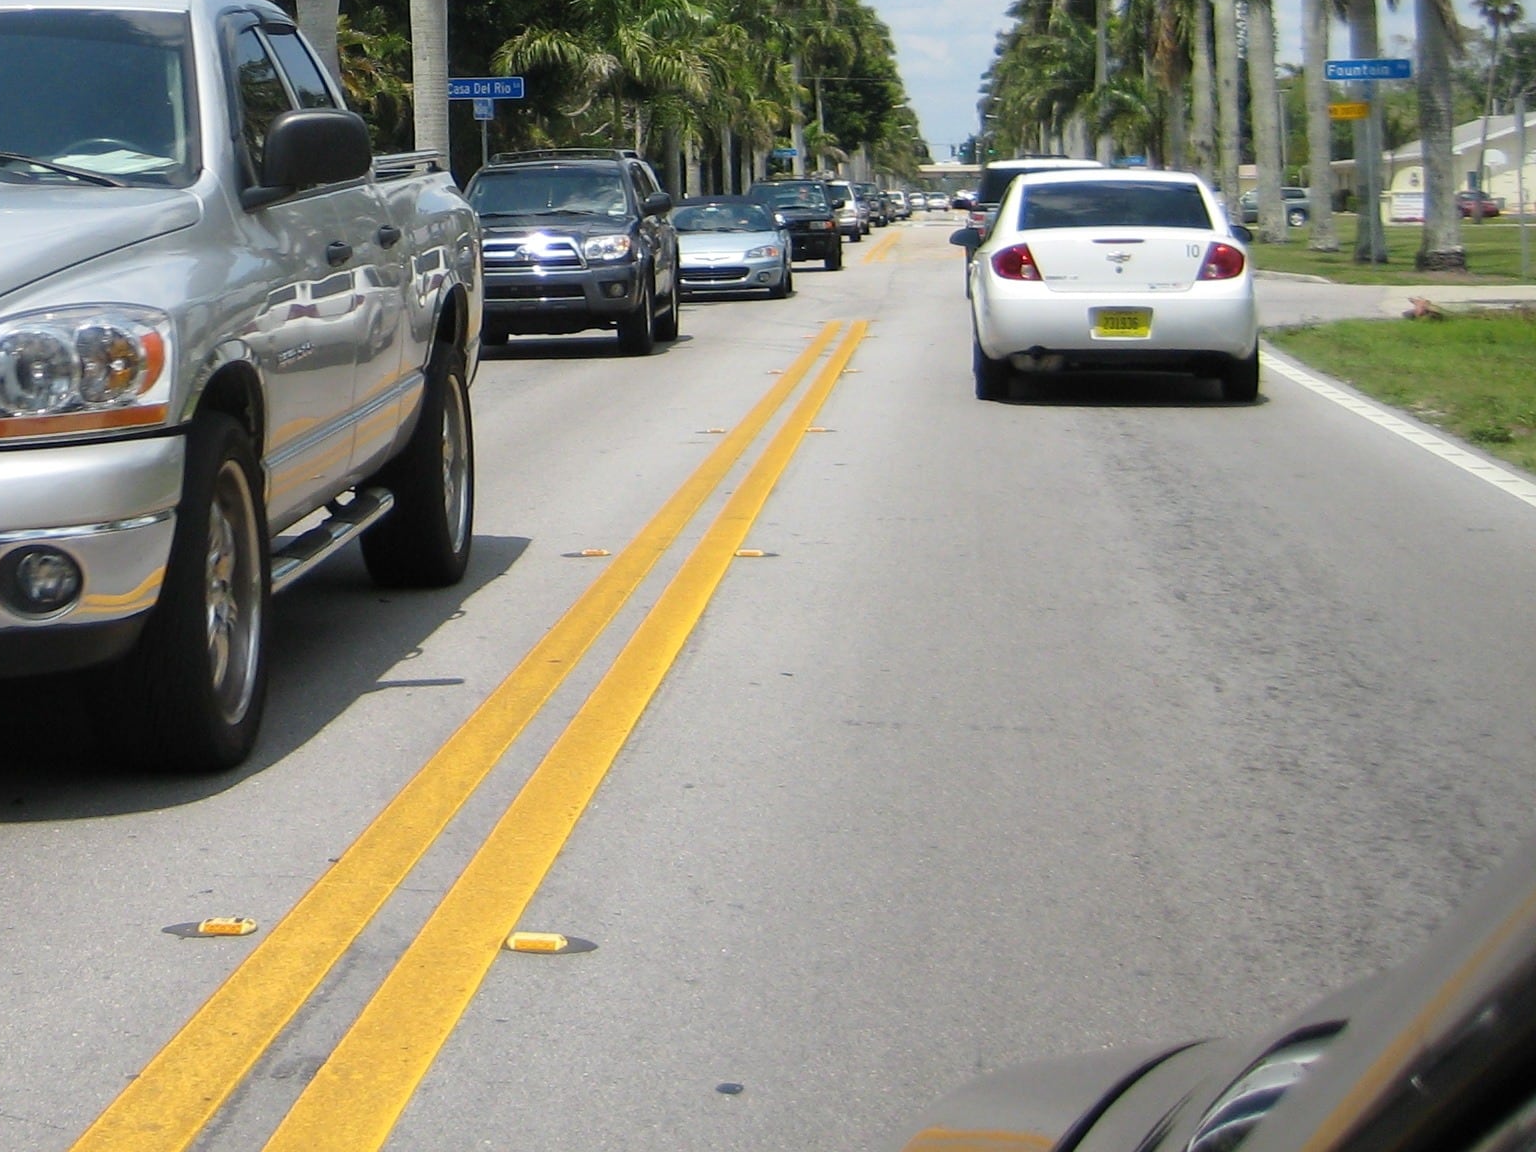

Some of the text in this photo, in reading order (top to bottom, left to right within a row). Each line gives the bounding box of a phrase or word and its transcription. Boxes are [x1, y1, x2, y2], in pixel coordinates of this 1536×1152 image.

[1326, 64, 1390, 77] Fountain
[448, 83, 471, 95] Casa
[473, 82, 491, 94] Del
[494, 82, 512, 94] Rio
[1186, 244, 1201, 259] 10
